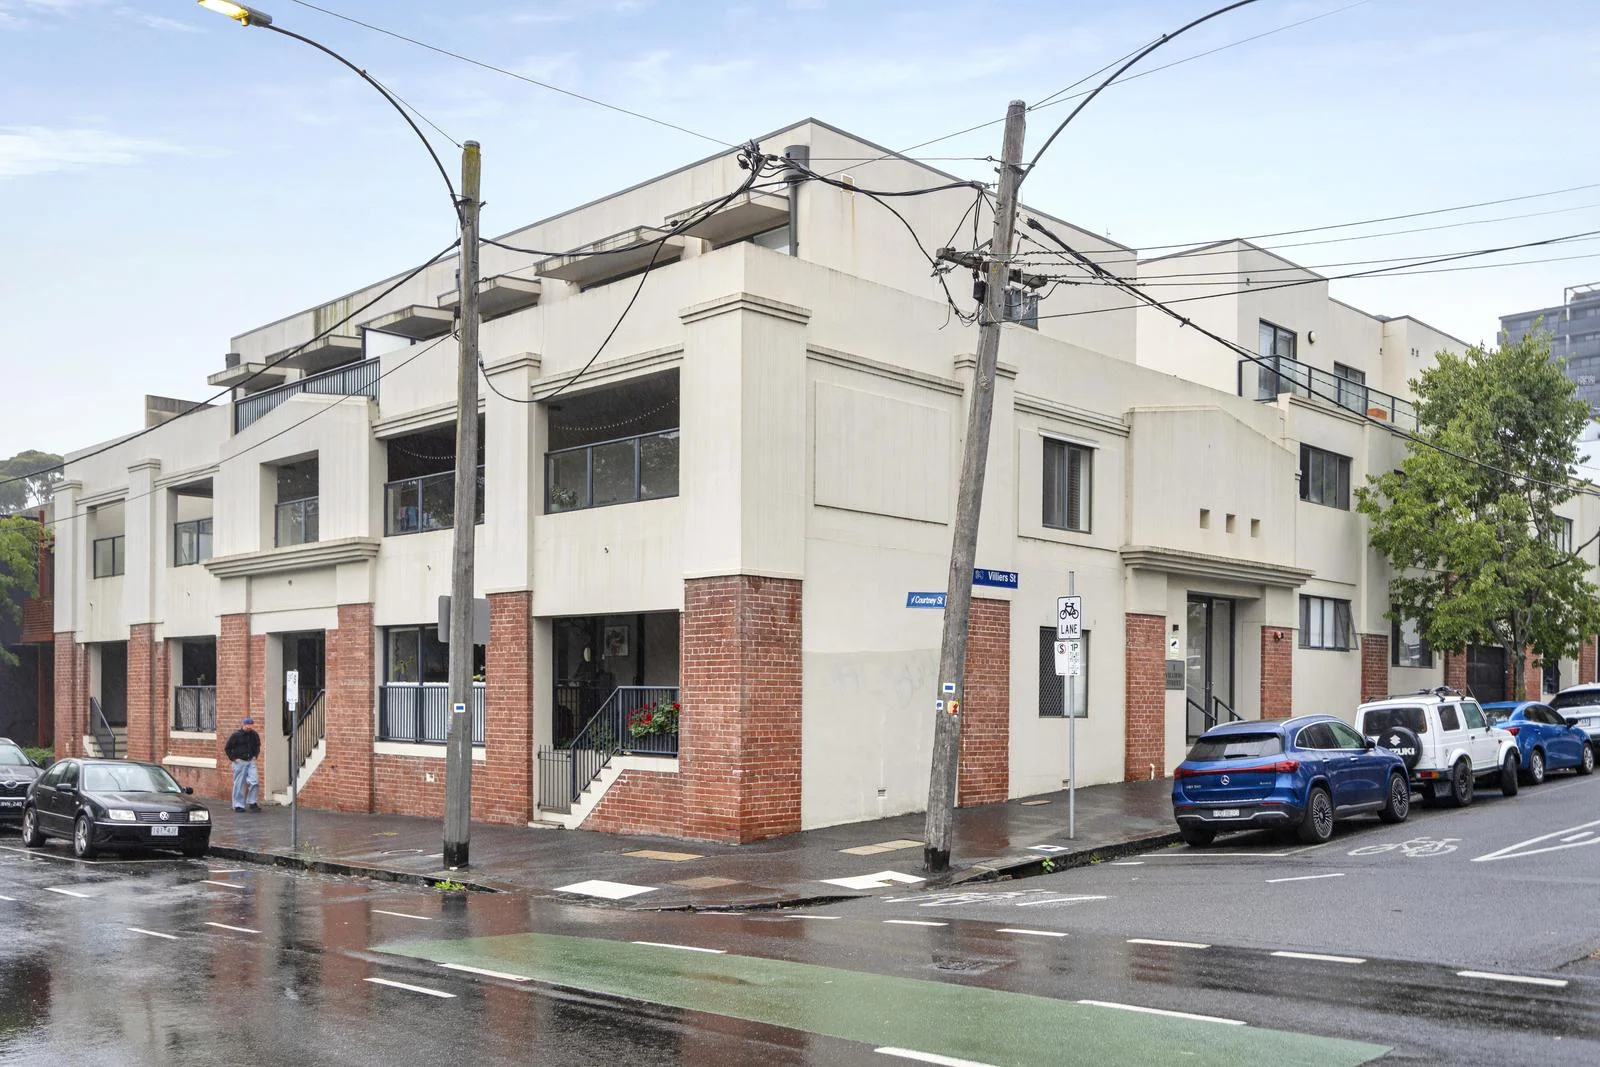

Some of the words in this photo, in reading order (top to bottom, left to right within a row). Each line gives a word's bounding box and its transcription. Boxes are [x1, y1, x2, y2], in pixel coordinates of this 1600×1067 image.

[988, 570, 1009, 583] Villiers
[1009, 573, 1017, 583] St
[915, 595, 937, 606] Courtney
[937, 596, 943, 605] St
[1060, 623, 1078, 635] LANE
[1070, 643, 1079, 652] 1P
[1389, 747, 1415, 756] ZUKI
